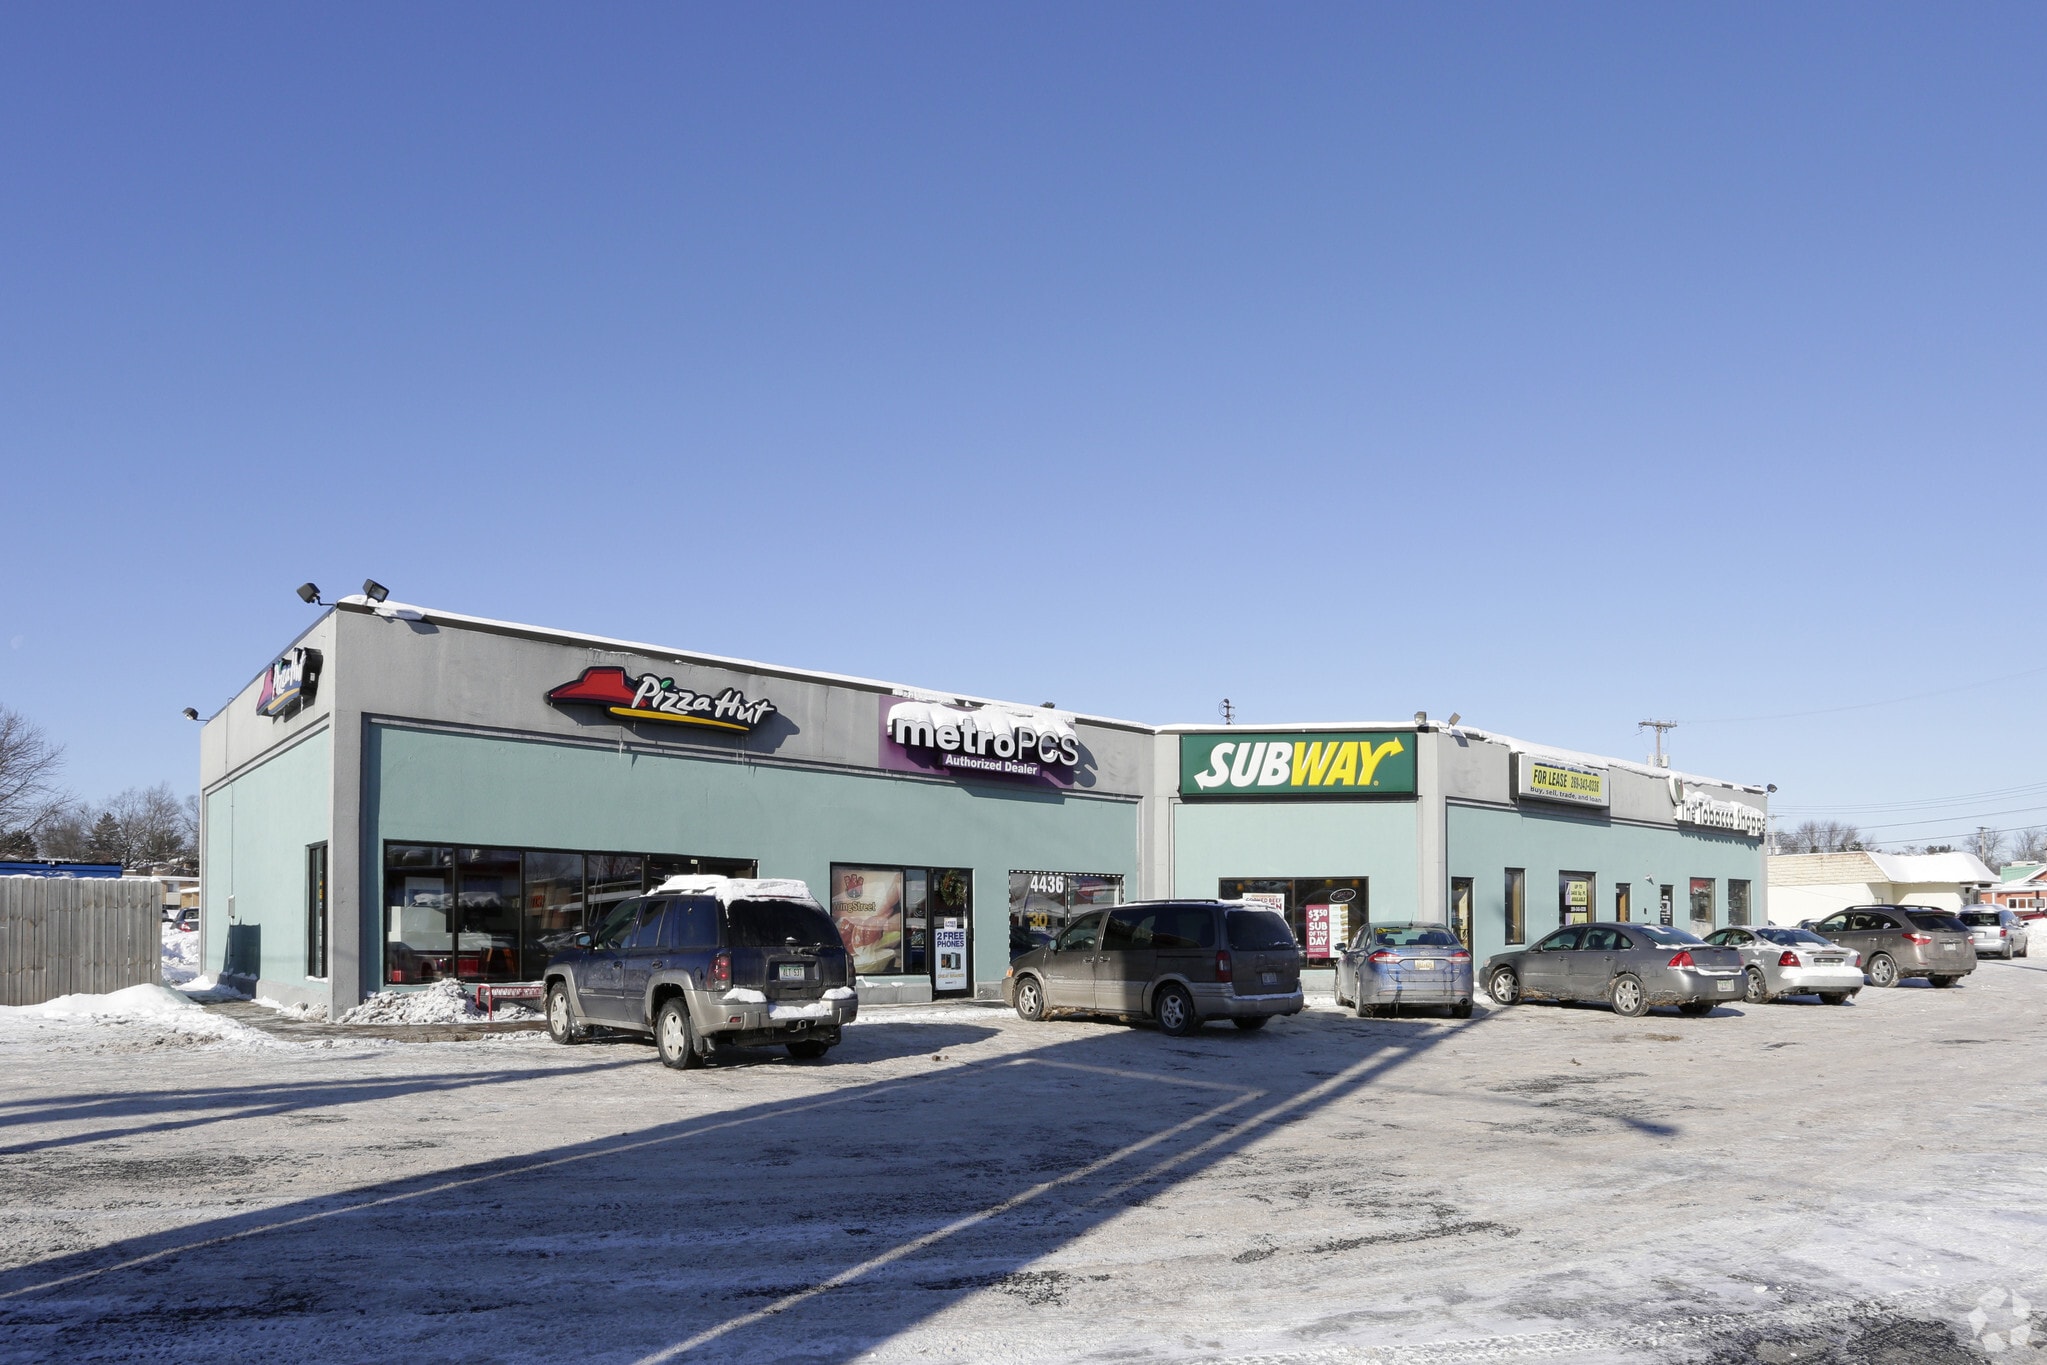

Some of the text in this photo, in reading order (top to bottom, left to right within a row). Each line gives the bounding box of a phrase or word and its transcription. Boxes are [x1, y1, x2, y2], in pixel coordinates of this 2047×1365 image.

[631, 675, 775, 724] Pizza Hut
[895, 718, 1080, 766] metroPCS
[945, 754, 1038, 775] Authorized Dealer
[1194, 737, 1404, 790] SUBWAY
[1533, 769, 1547, 785] FOR
[1548, 771, 1568, 788] LEASE
[1530, 786, 1545, 795] Buy,
[1545, 789, 1559, 797] sell,
[1559, 791, 1577, 800] trade,
[1697, 802, 1734, 828] Tobacco
[1735, 807, 1766, 836] Shoppe
[1030, 875, 1064, 893] 4436
[936, 931, 965, 940] 2 FREE
[1308, 922, 1328, 931] SUB
[936, 940, 965, 948] PHONES
[1309, 937, 1328, 945] DAY
